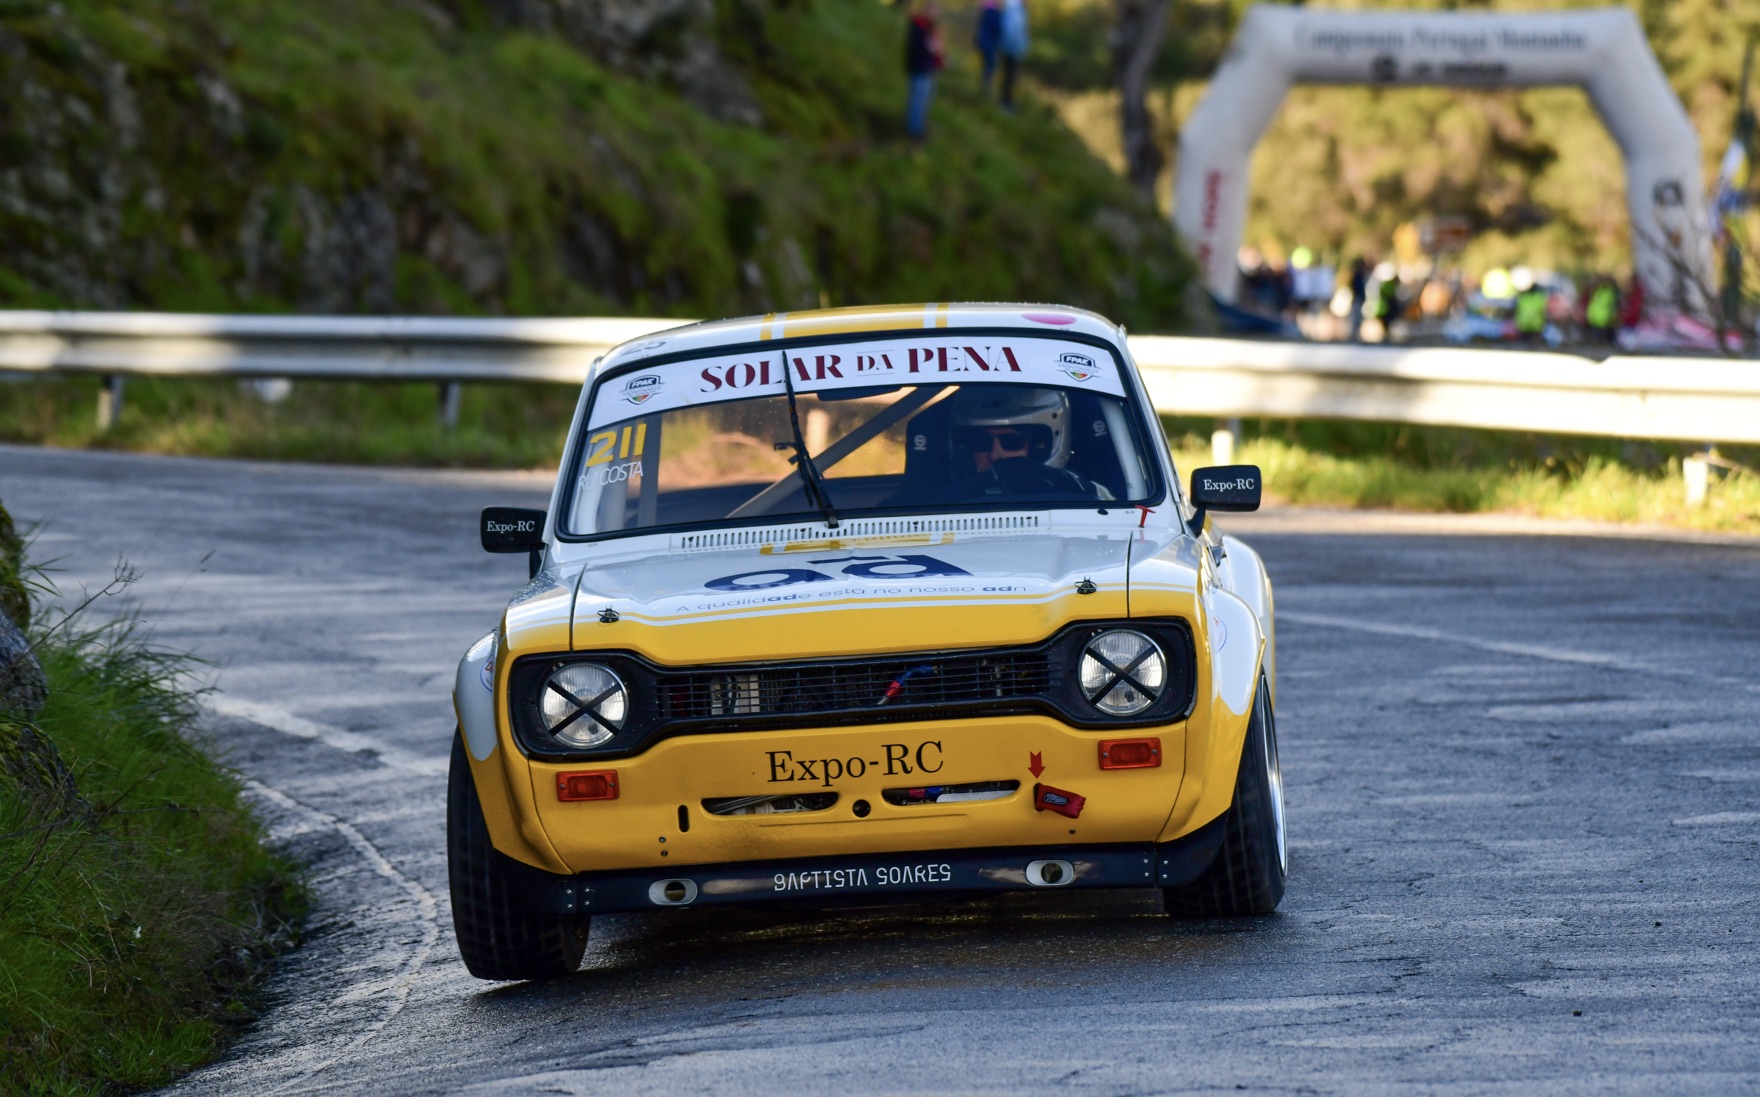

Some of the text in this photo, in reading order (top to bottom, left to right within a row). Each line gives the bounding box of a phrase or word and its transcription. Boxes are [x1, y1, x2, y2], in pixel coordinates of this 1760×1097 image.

[699, 346, 1022, 393] SOLAR DA PENA
[1065, 355, 1089, 366] FPAK
[631, 378, 655, 388] FPAK
[586, 423, 647, 468] 211
[600, 461, 644, 486] COSTA
[1203, 478, 1255, 492] Expo-RC
[486, 520, 536, 534] Expo-RC
[697, 593, 811, 610] qualidade
[909, 585, 975, 593] nosso
[982, 585, 1027, 593] adn
[765, 740, 944, 788] Expo-RC
[774, 864, 951, 891] BAPTISTA SOARES
